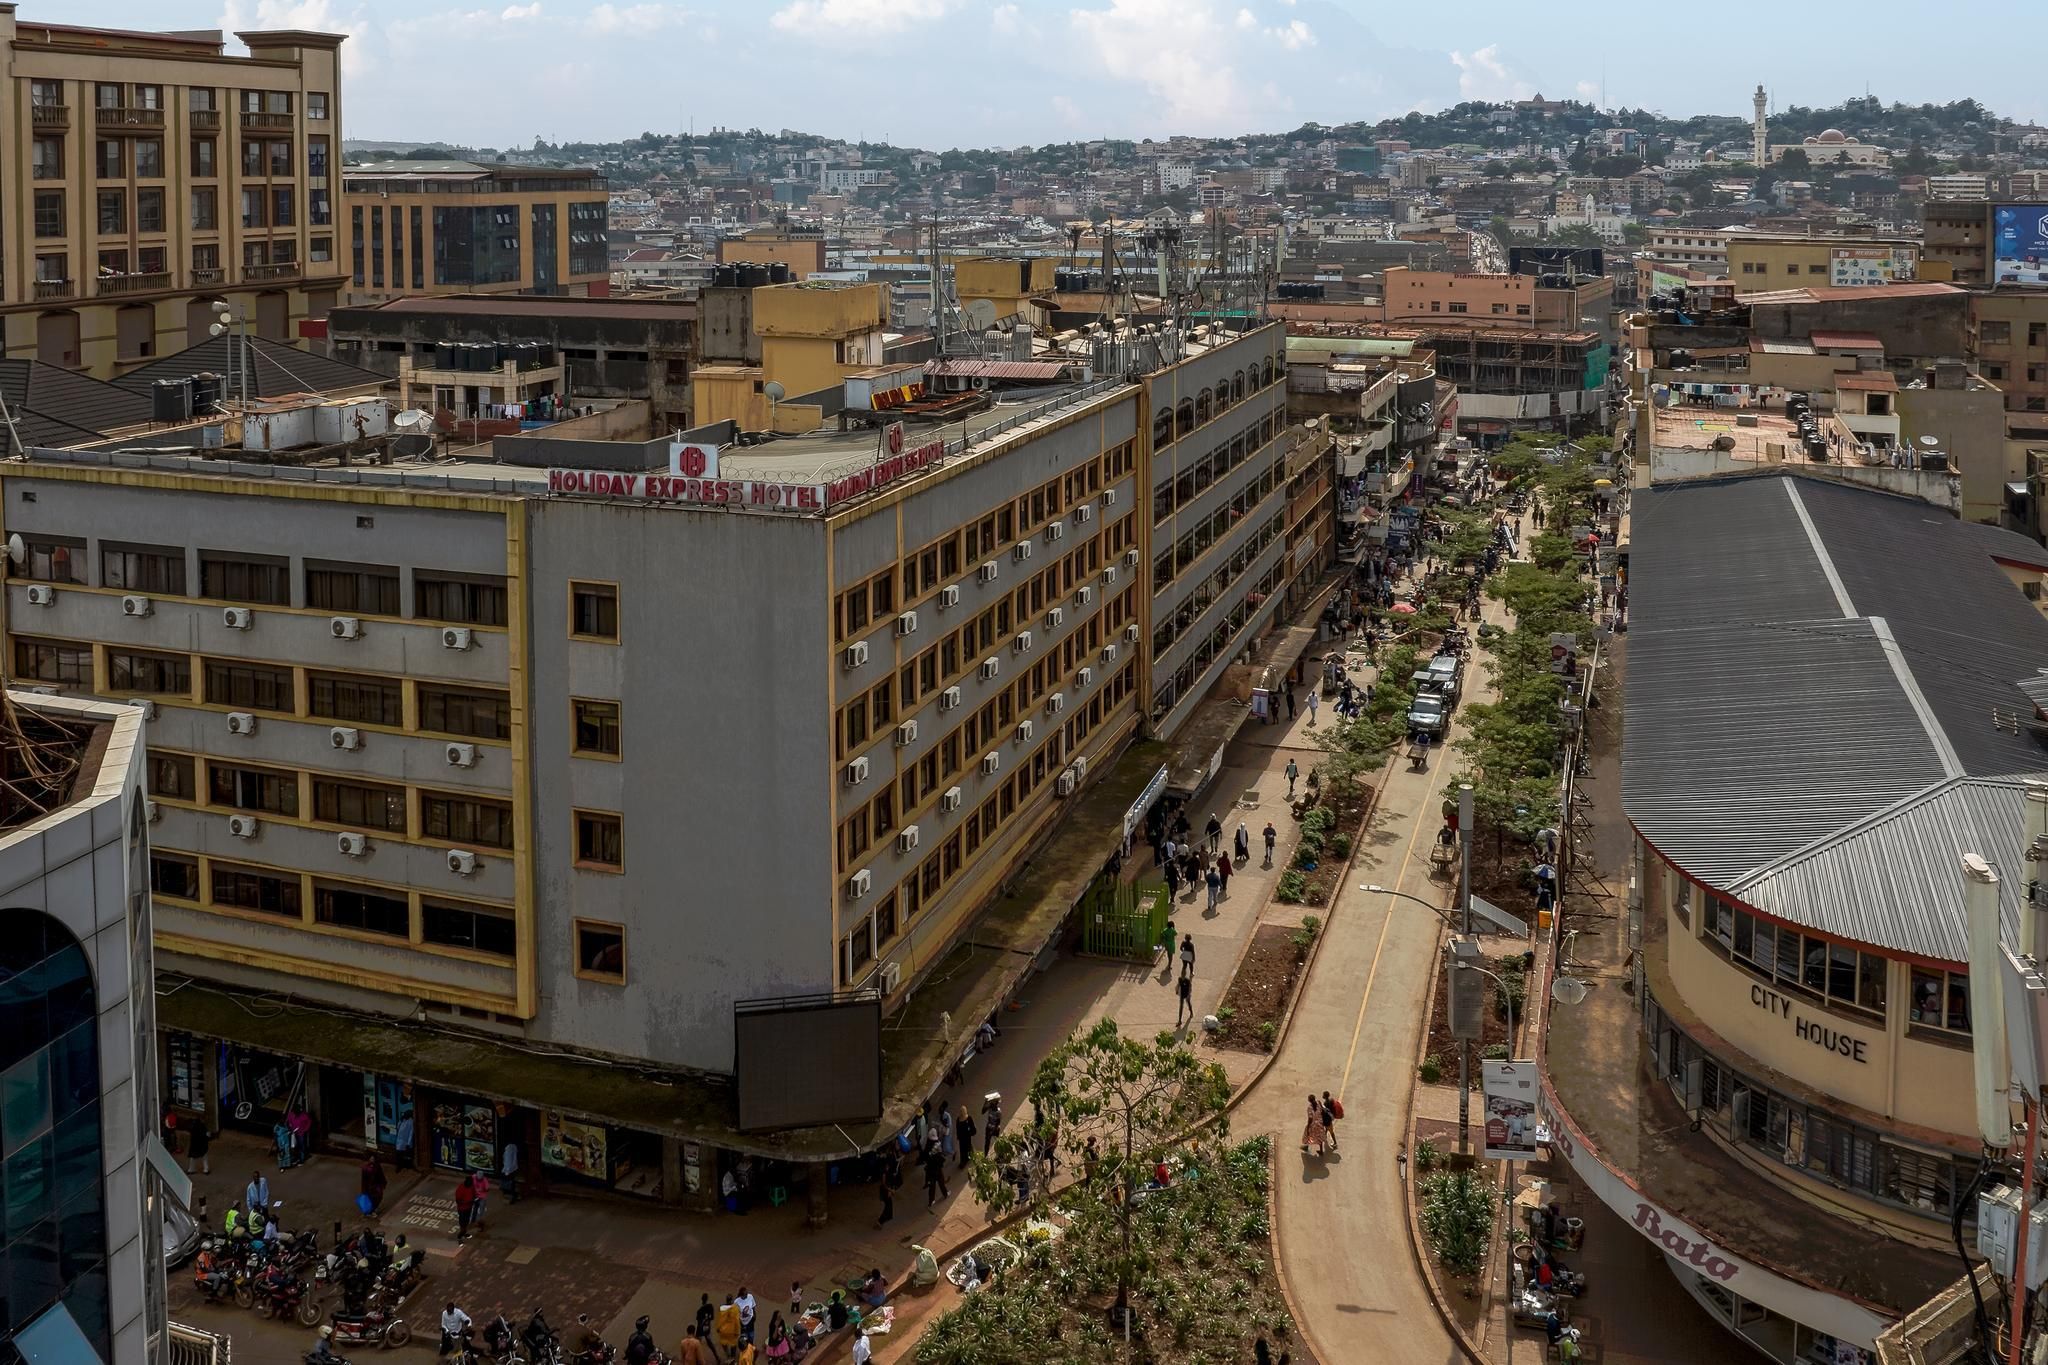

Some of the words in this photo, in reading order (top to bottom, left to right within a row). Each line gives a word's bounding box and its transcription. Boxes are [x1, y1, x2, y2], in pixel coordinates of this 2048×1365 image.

[549, 470, 638, 497] HOLIDAY
[645, 476, 744, 504] EXPRESS
[751, 482, 822, 508] HOTEL
[827, 466, 873, 506] HOLIDAY
[1751, 984, 1790, 1019] CITY
[1796, 1016, 1867, 1064] HOUSE
[402, 1215, 440, 1228] HOTEL
[407, 1205, 459, 1220] EXPRES
[1632, 1203, 1739, 1281] Bata
